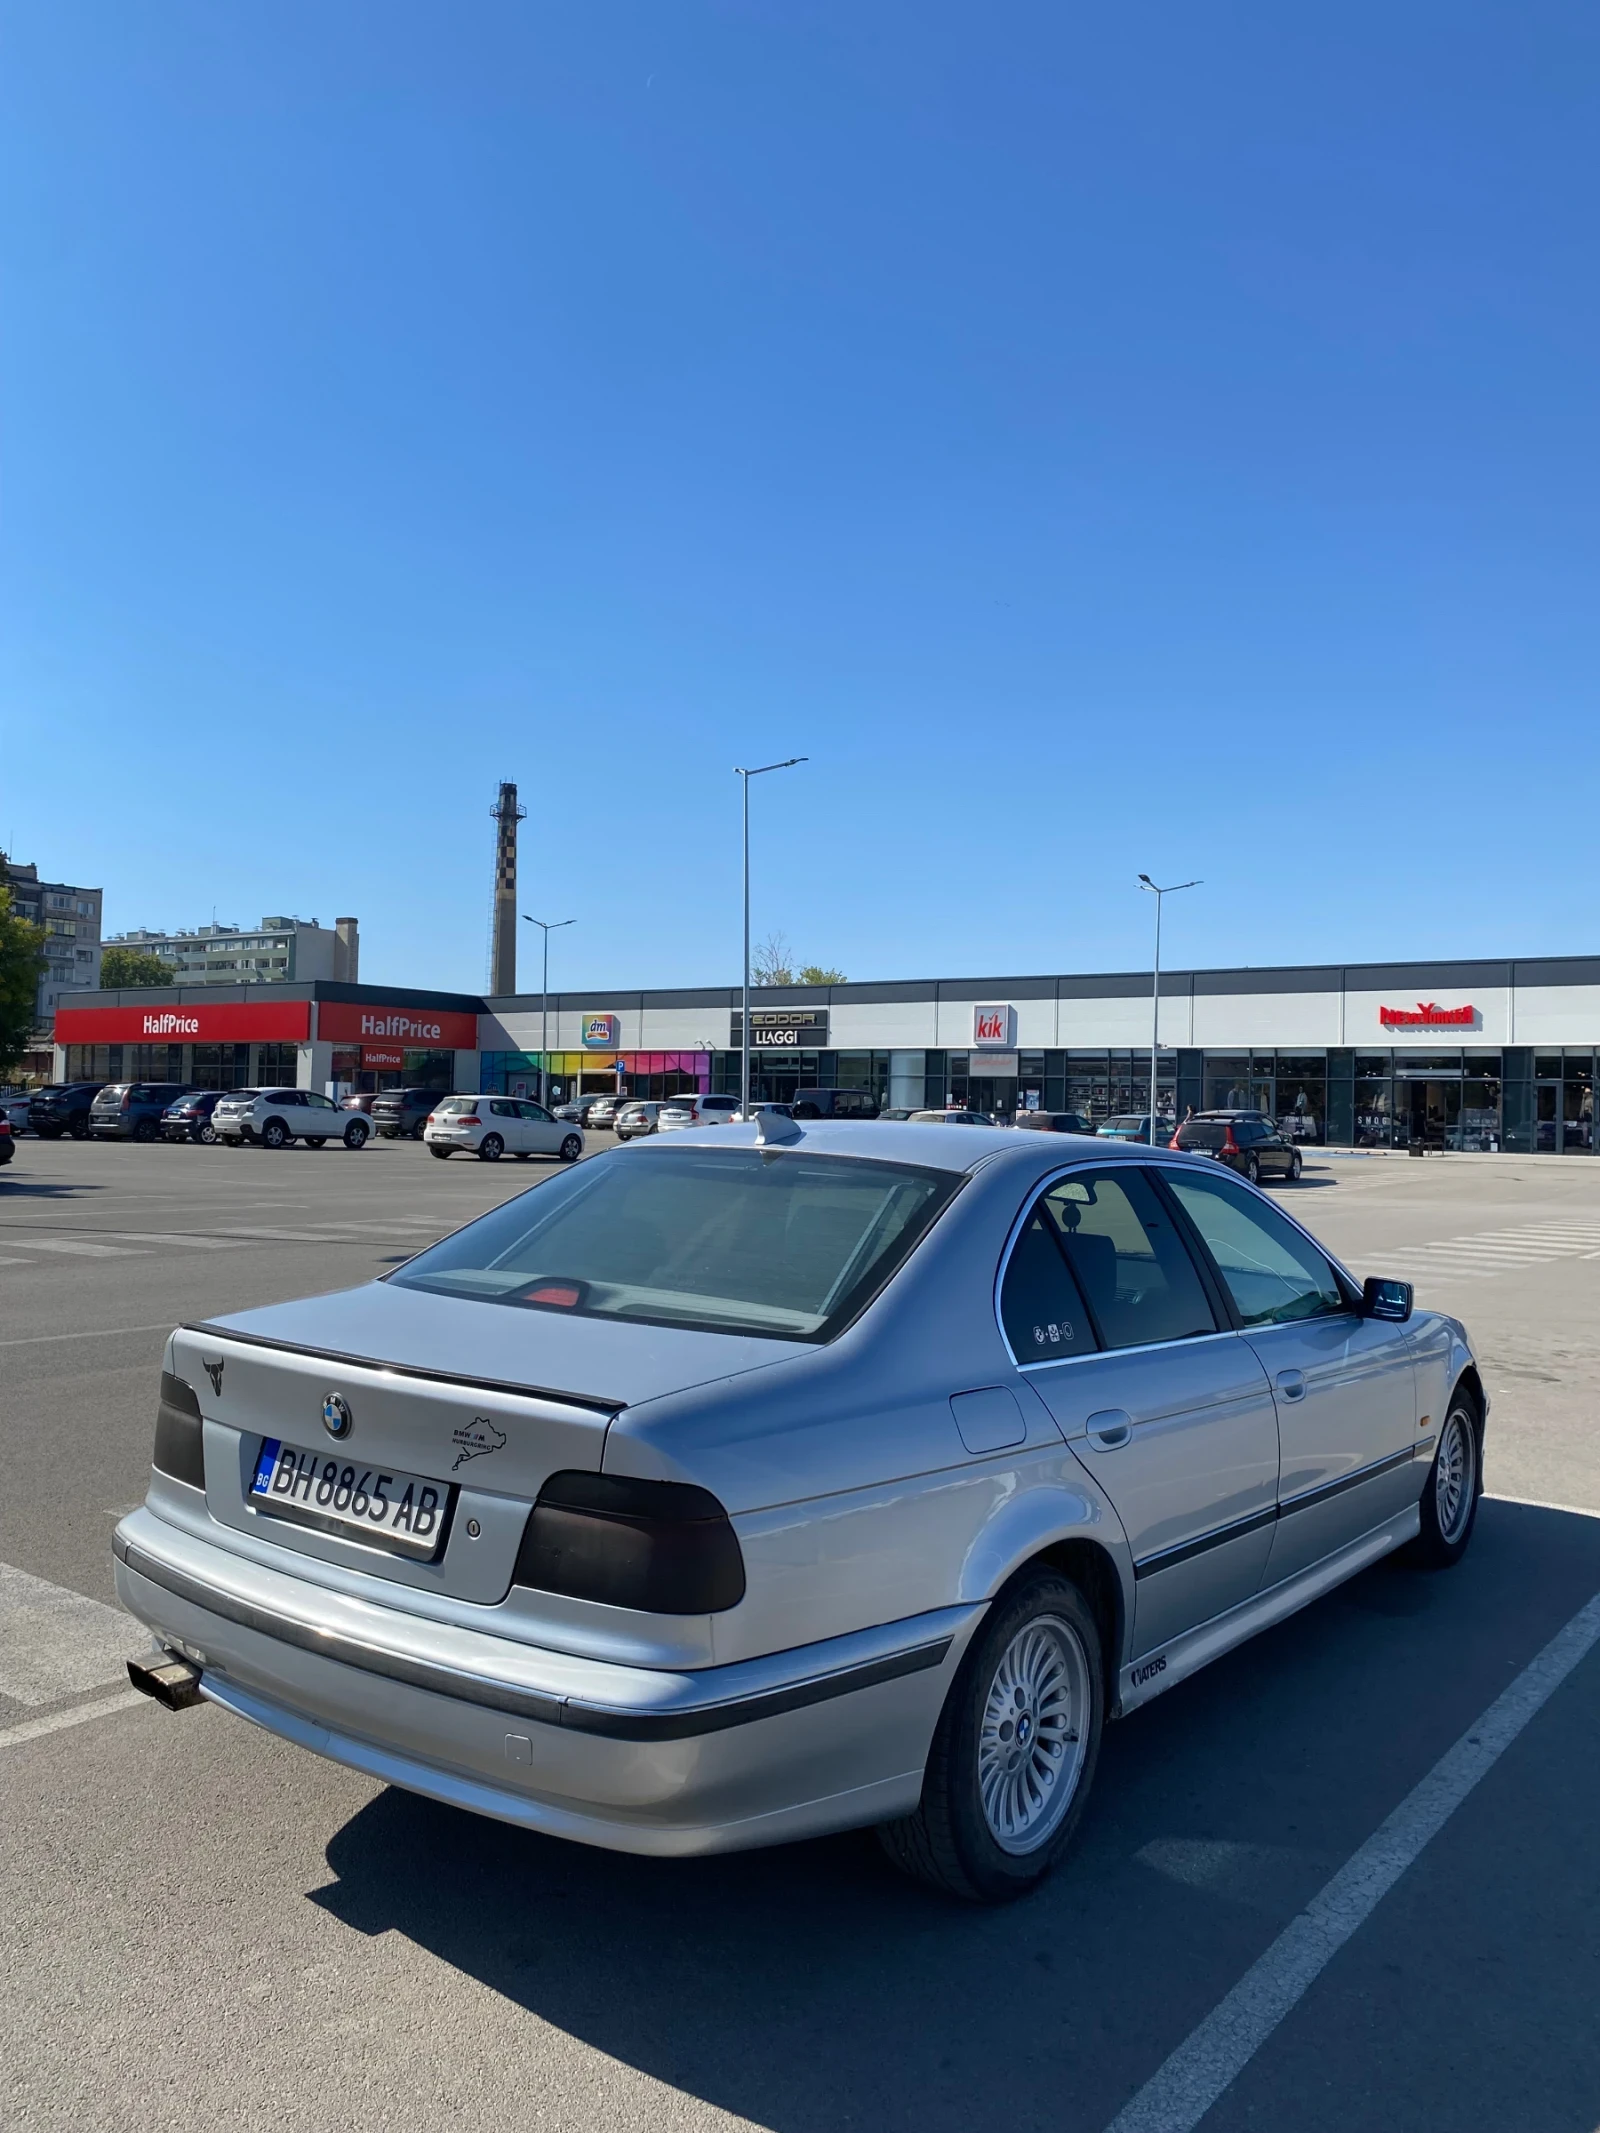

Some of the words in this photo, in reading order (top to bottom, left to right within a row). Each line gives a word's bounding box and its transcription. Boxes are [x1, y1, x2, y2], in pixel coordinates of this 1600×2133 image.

[143, 1014, 199, 1034] HalfPrice
[361, 1014, 441, 1039] HalfPrice
[590, 1019, 607, 1032] dm
[756, 1030, 798, 1045] LLAGGI
[365, 1053, 401, 1064] HalfPrice
[618, 1063, 624, 1071] P
[1358, 1116, 1387, 1125] SMOG
[453, 1429, 471, 1439] BMW
[255, 1472, 270, 1488] BG
[272, 1449, 319, 1501] BH
[316, 1461, 394, 1522] 8865
[391, 1483, 439, 1536] AB
